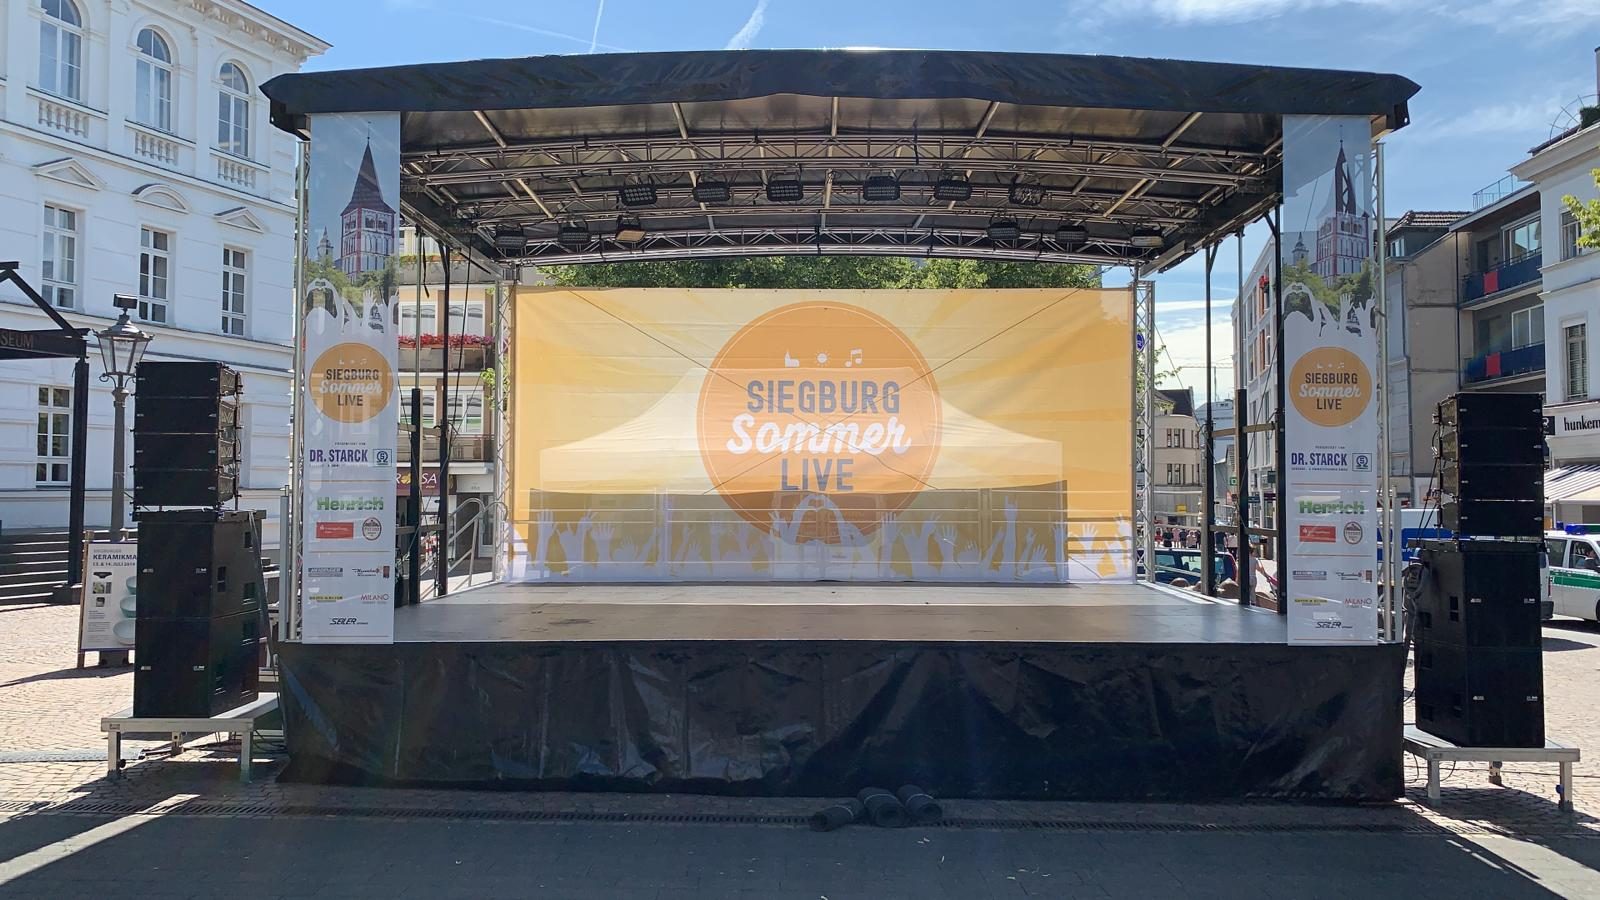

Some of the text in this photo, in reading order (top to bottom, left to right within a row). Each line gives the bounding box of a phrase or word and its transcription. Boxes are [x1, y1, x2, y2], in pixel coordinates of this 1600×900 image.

[326, 368, 379, 380] SIEGBURG
[1305, 372, 1358, 385] SIEGBURG
[320, 380, 382, 395] Sommer
[1299, 383, 1361, 398] Sommer
[337, 394, 364, 406] LIVE
[747, 380, 900, 414] SIEGBURG
[1316, 398, 1342, 410] LIVE
[726, 413, 911, 455] Sommer
[309, 449, 368, 463] DR. STARCK
[1291, 452, 1348, 466] DR. STARCK
[781, 458, 854, 492] LIVE
[316, 496, 384, 511] Henrich
[1299, 500, 1365, 514] Henrich
[360, 593, 389, 601] MILANO
